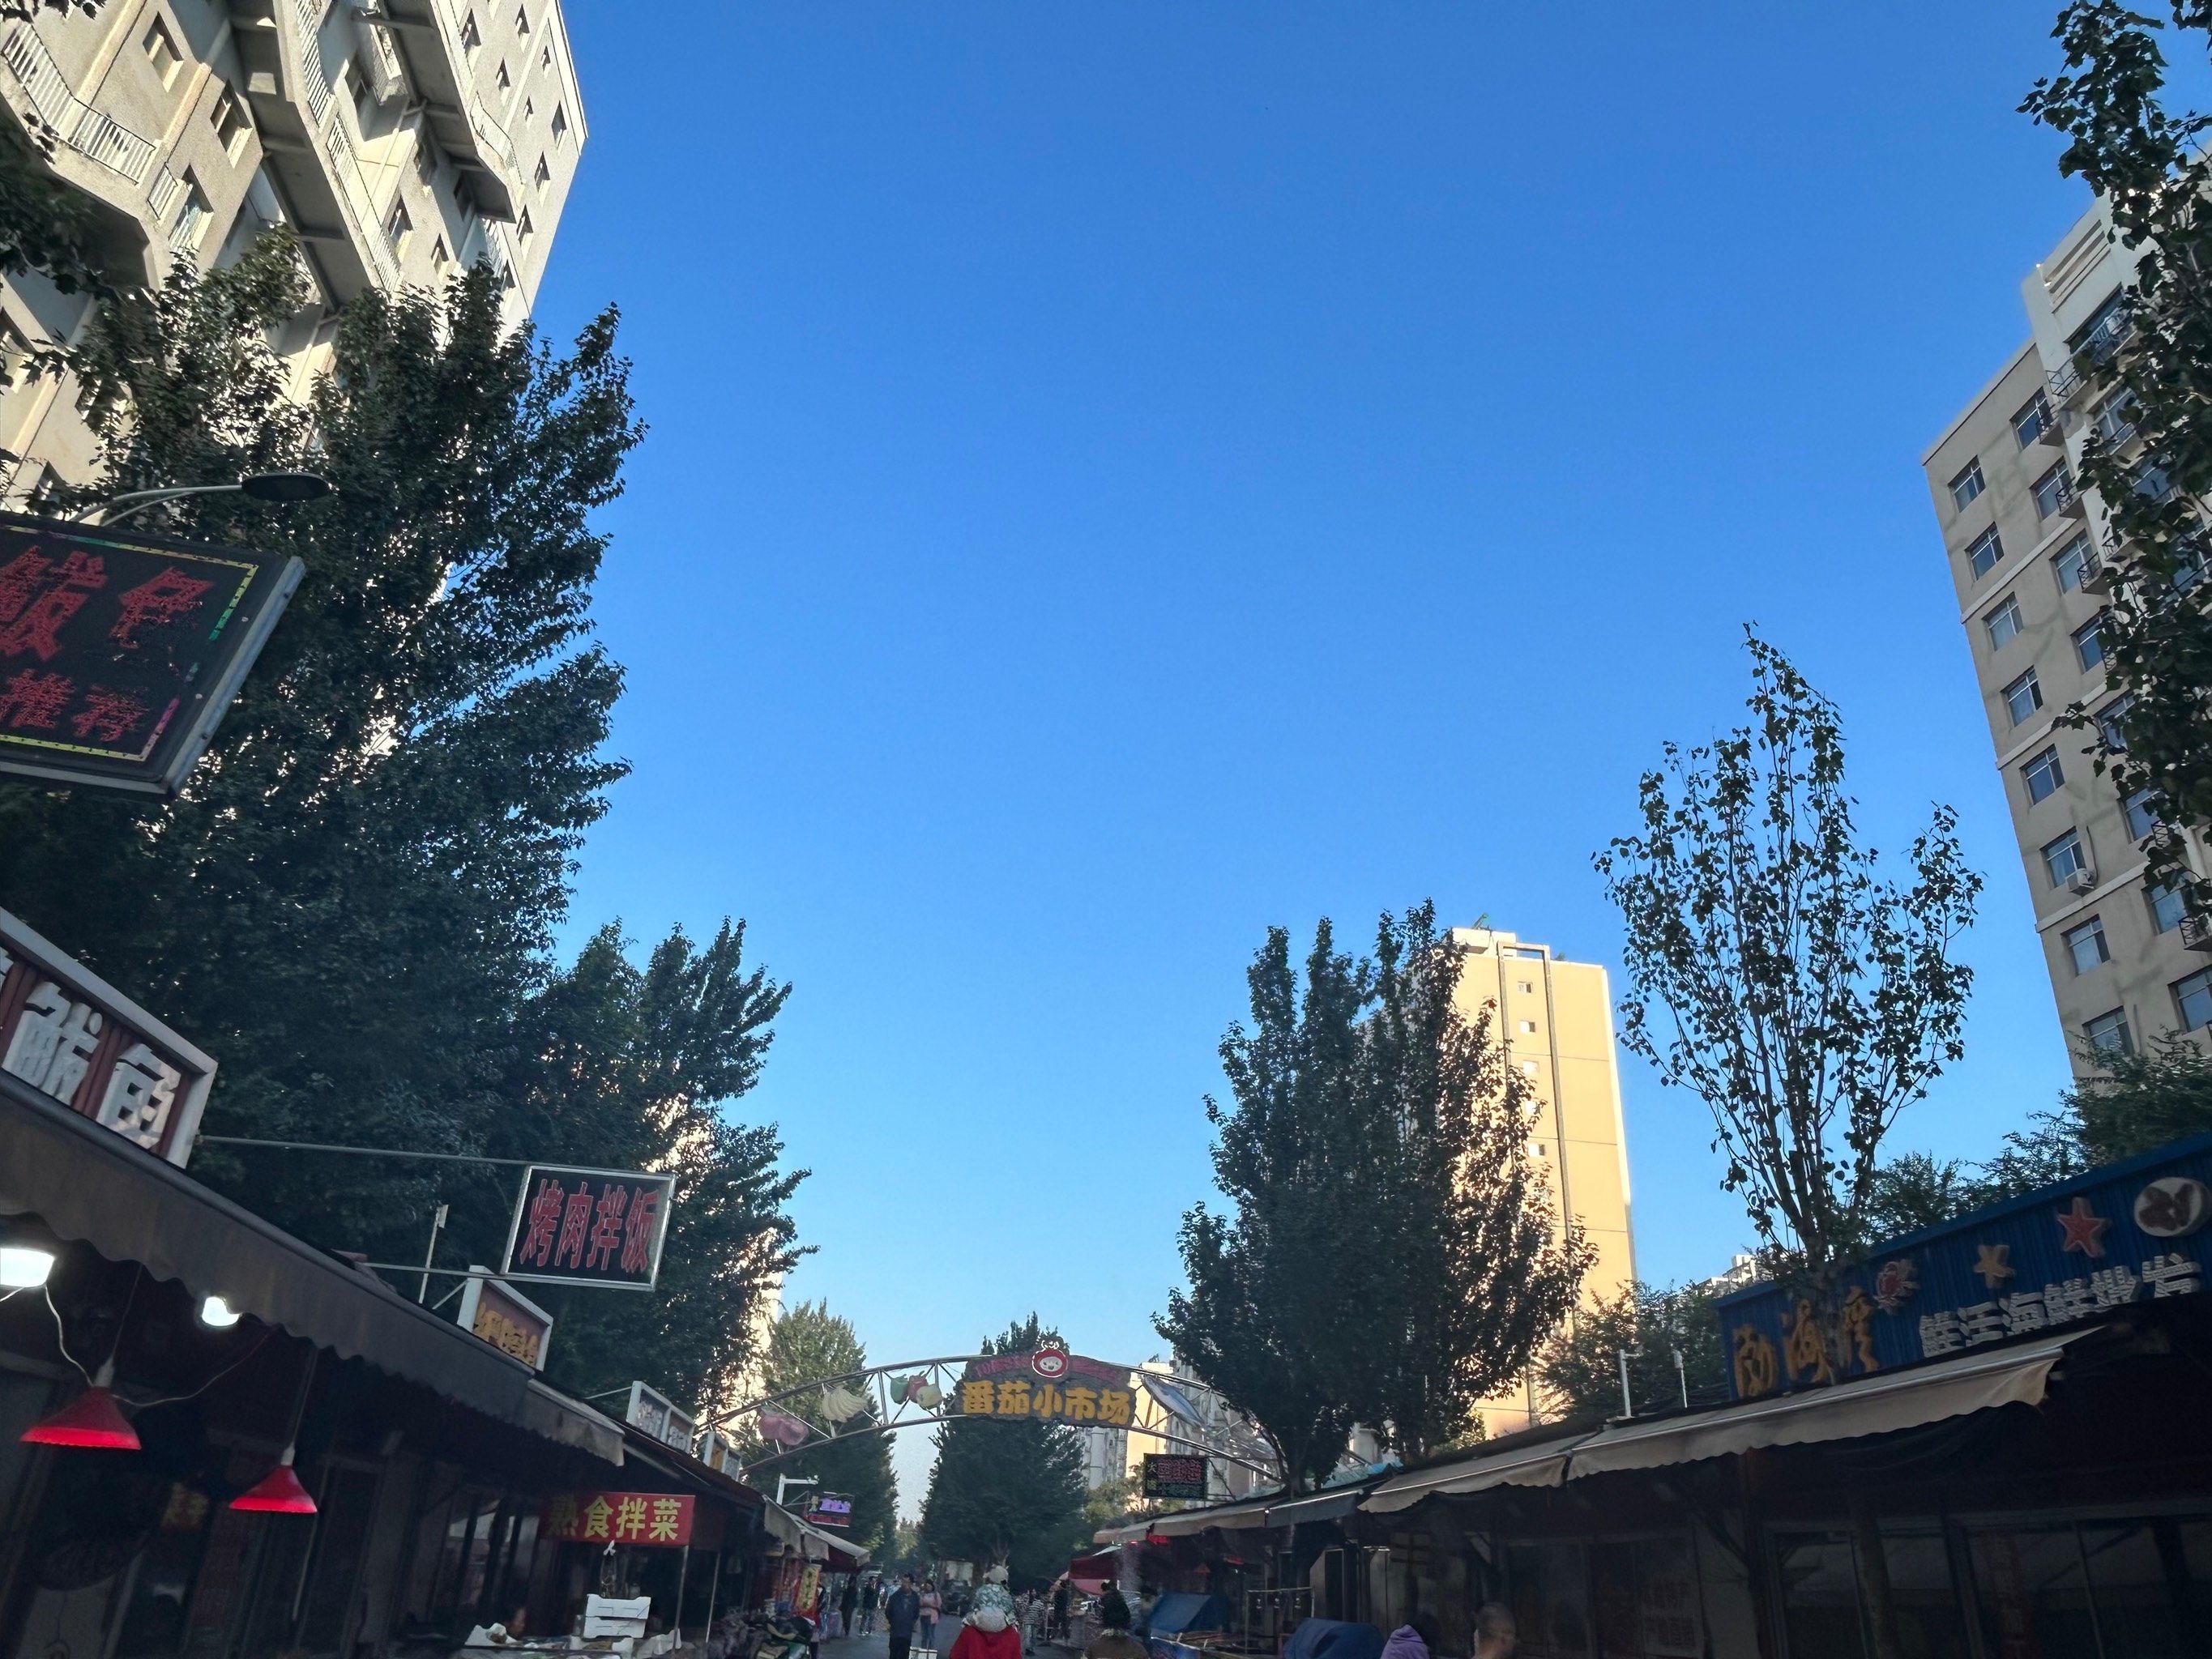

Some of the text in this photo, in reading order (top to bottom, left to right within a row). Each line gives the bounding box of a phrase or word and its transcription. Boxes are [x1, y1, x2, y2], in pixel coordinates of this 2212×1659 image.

[0, 947, 181, 1149] 鱿鱼
[520, 1178, 659, 1273] 烤肉拌饭
[962, 1380, 1130, 1425] 番茄小市场
[549, 1494, 681, 1542] 熟食拌菜
